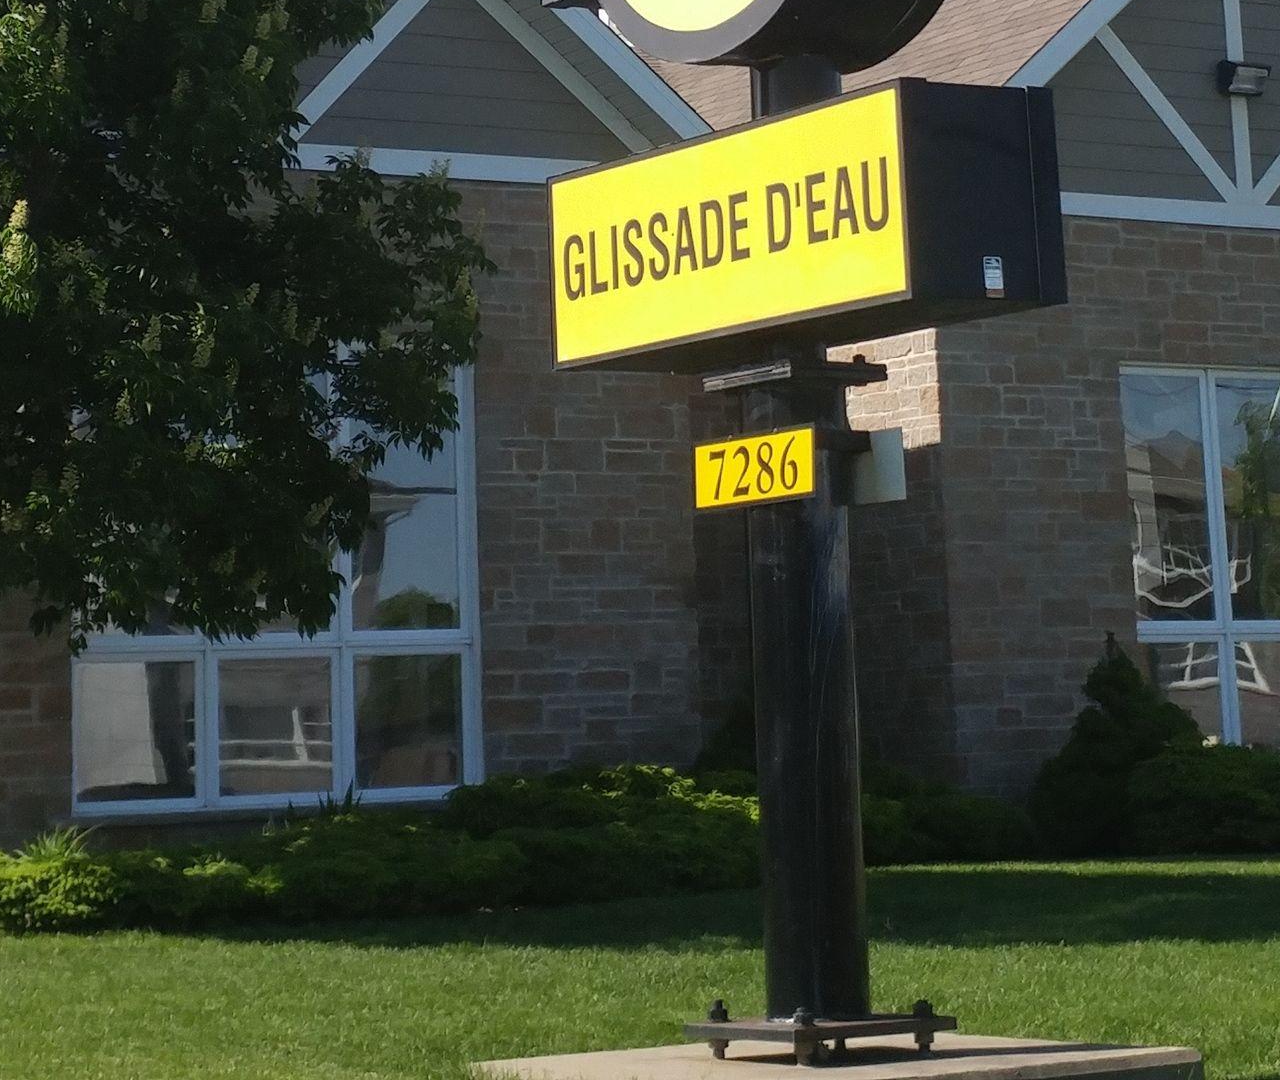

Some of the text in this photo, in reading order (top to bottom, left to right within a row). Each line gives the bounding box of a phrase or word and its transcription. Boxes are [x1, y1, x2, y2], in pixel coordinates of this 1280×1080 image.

[563, 156, 890, 302] GLISSADE D'EAU
[707, 435, 799, 500] 7286
